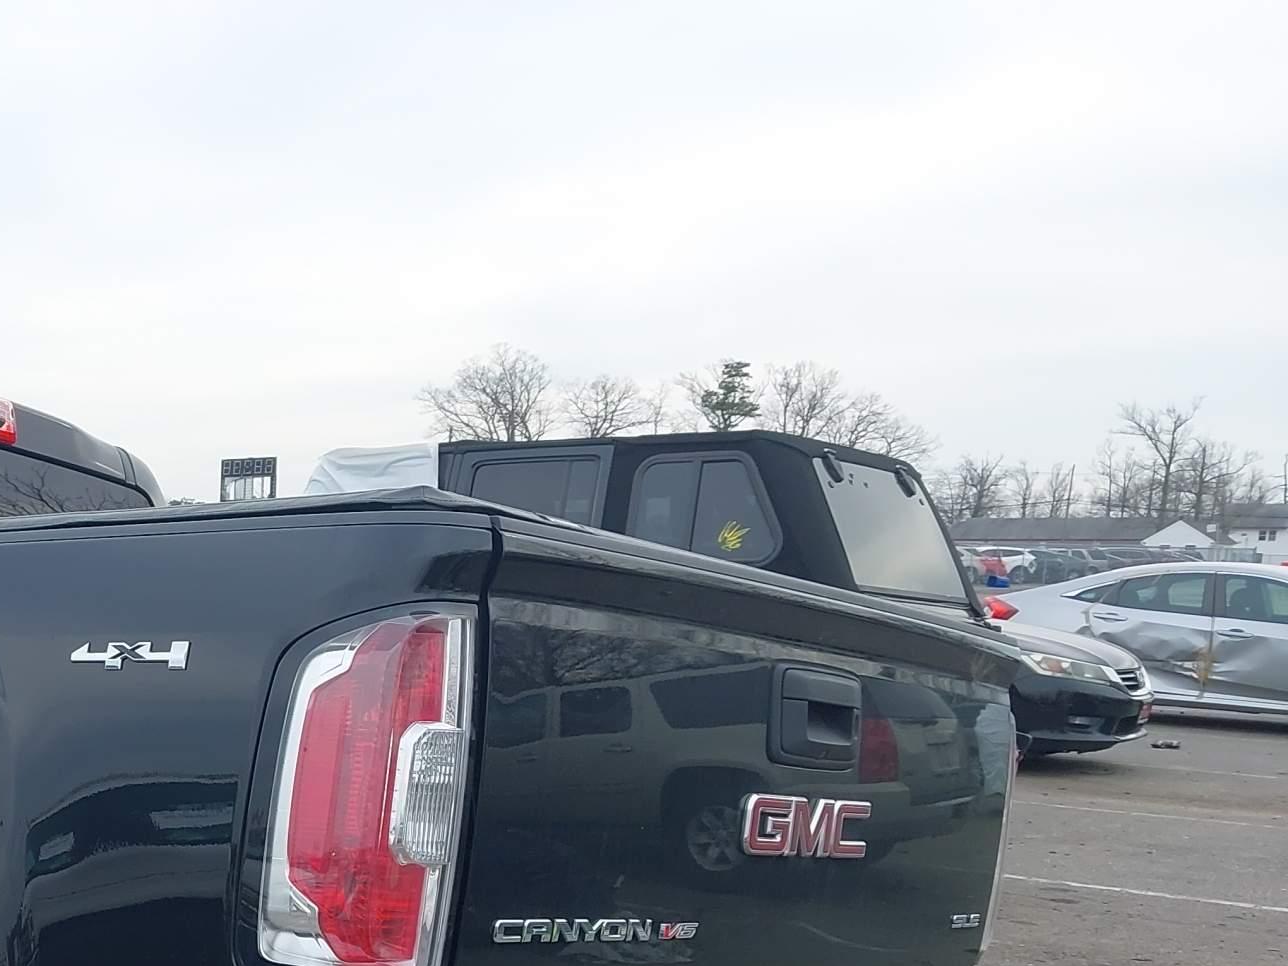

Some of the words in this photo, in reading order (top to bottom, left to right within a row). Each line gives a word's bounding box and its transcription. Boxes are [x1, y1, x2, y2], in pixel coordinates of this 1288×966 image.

[742, 793, 872, 858] GMC
[493, 918, 653, 943] CANYON
[658, 922, 699, 939] V6
[951, 913, 981, 929] SLE
